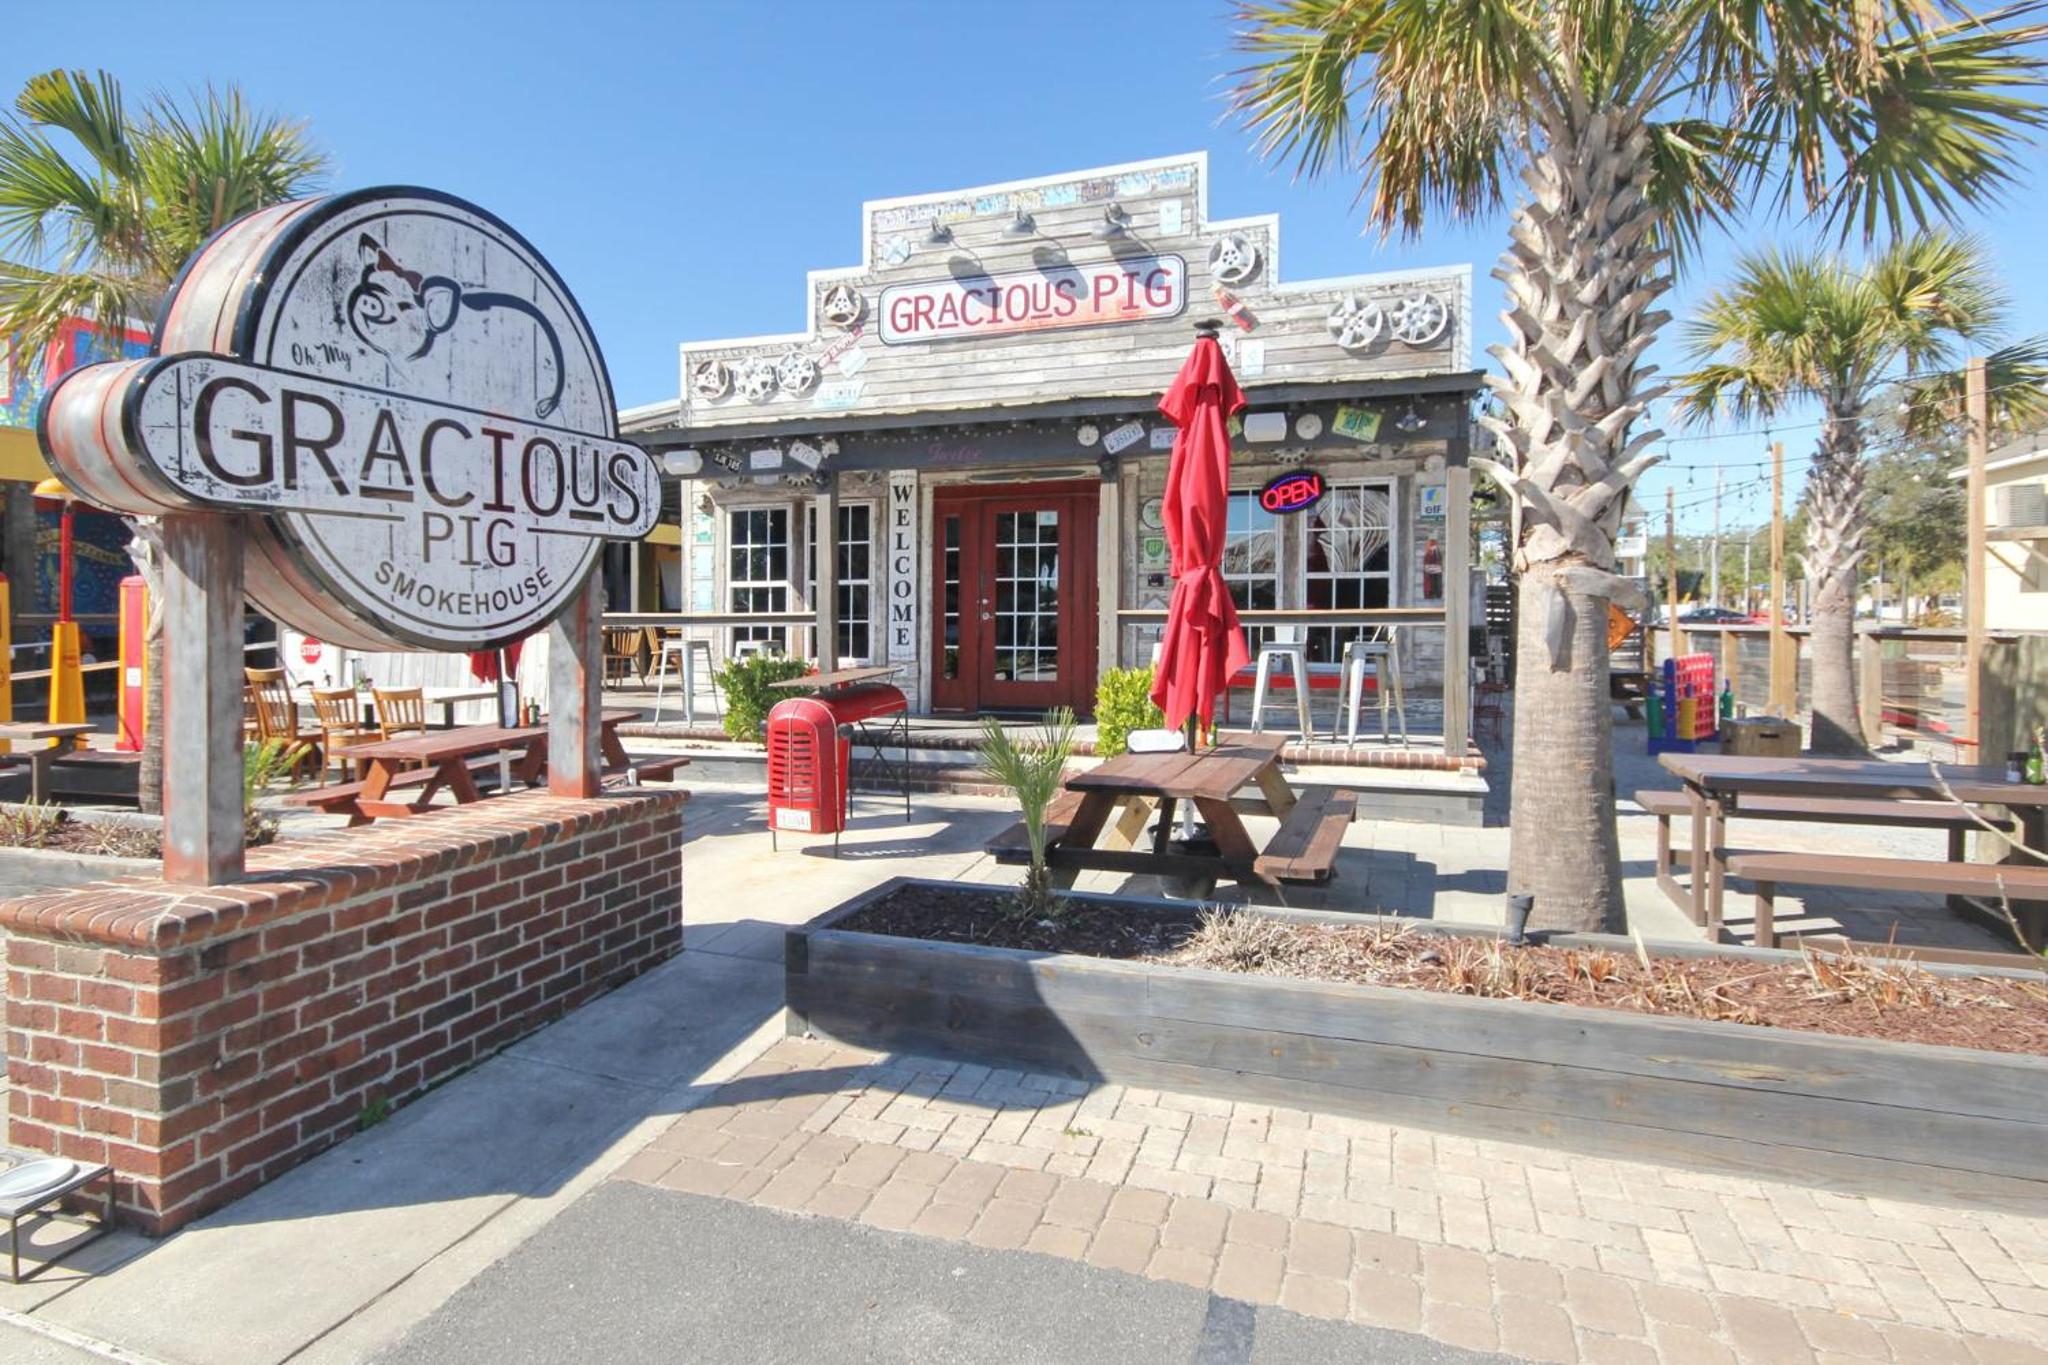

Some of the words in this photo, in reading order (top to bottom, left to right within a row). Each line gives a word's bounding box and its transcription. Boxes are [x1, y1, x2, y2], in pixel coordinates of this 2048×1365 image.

[890, 277, 1078, 334] GRACIOUS
[1094, 267, 1174, 314] PIG
[291, 342, 315, 367] Oh
[313, 342, 352, 372] My
[193, 376, 640, 527] GRACIOUS
[1261, 475, 1320, 511] OPEN
[423, 512, 517, 569] PIG
[892, 483, 914, 647] WELCOME
[374, 562, 553, 616] SMOKEHOUSE
[300, 644, 322, 655] STOP
